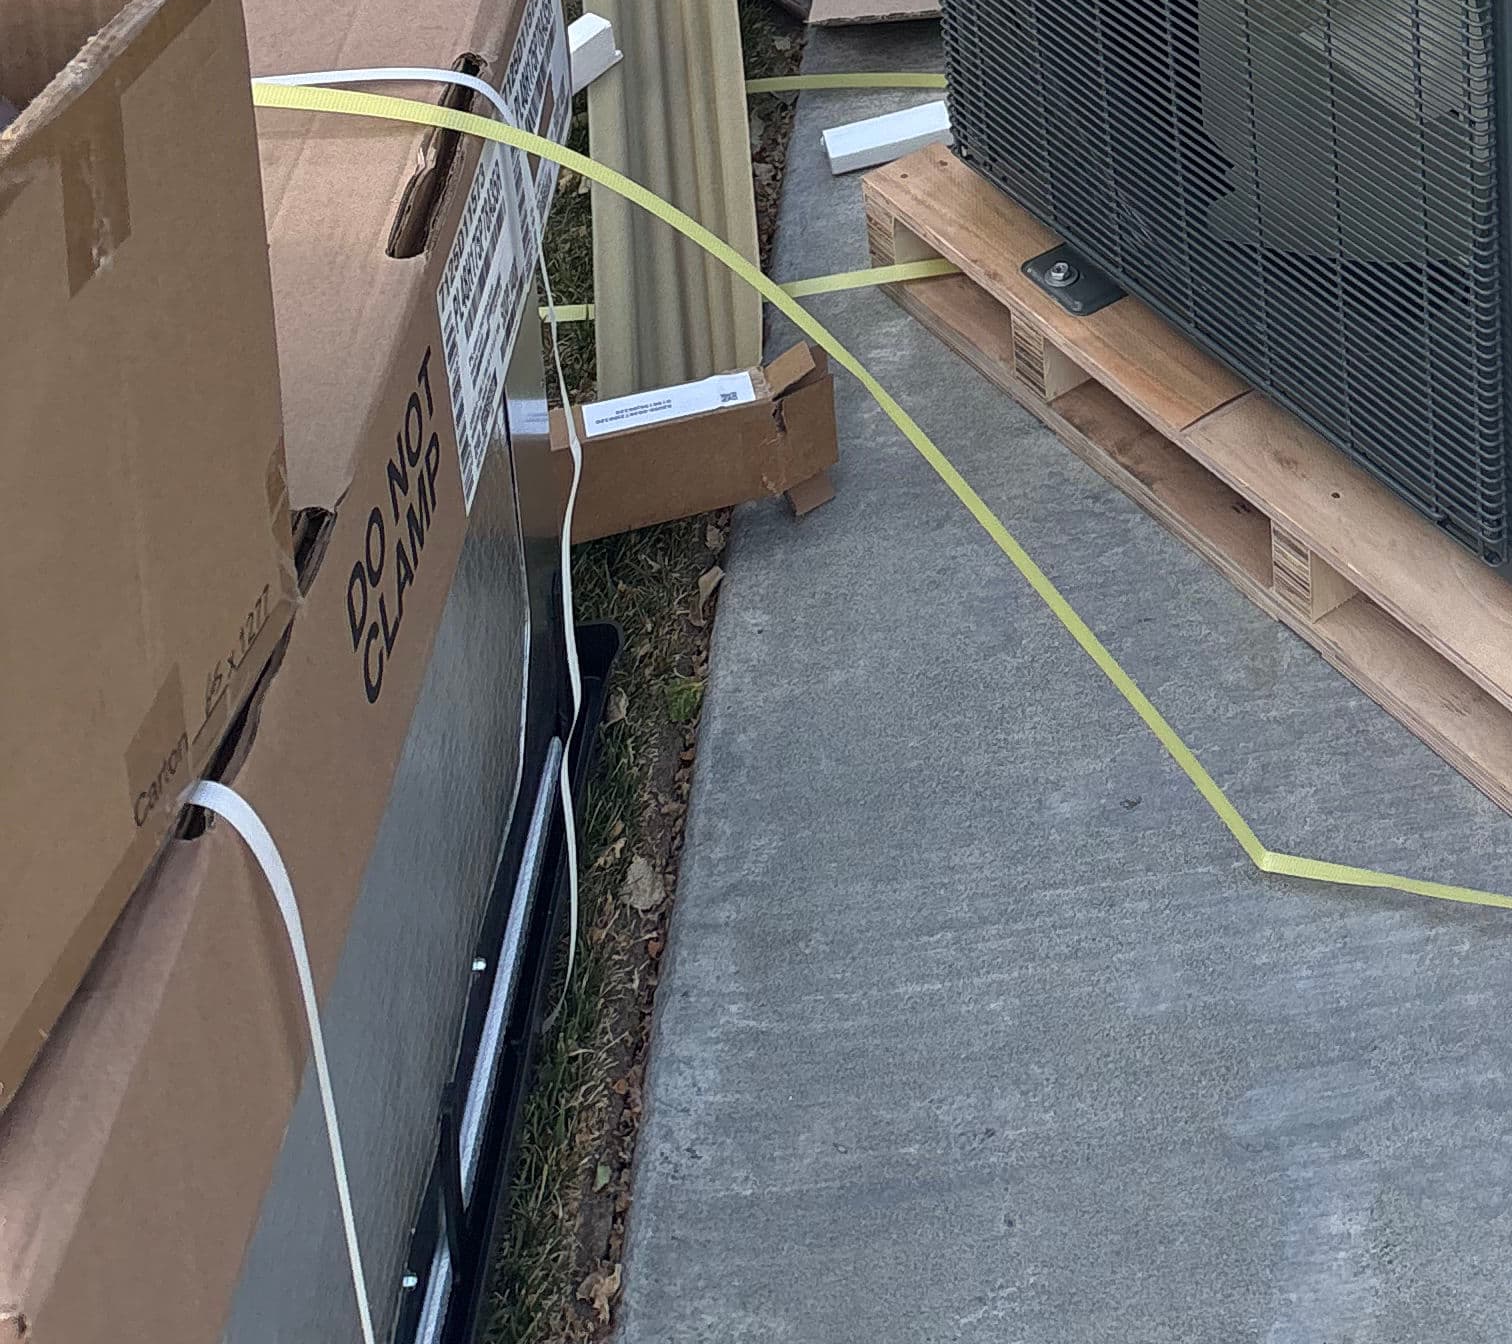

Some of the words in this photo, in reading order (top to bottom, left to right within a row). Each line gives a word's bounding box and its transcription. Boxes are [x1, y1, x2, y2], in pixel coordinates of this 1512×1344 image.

[348, 506, 386, 654] DO
[387, 344, 434, 527] NOT
[363, 430, 440, 705] CLAMP
[133, 732, 189, 827] Carton
